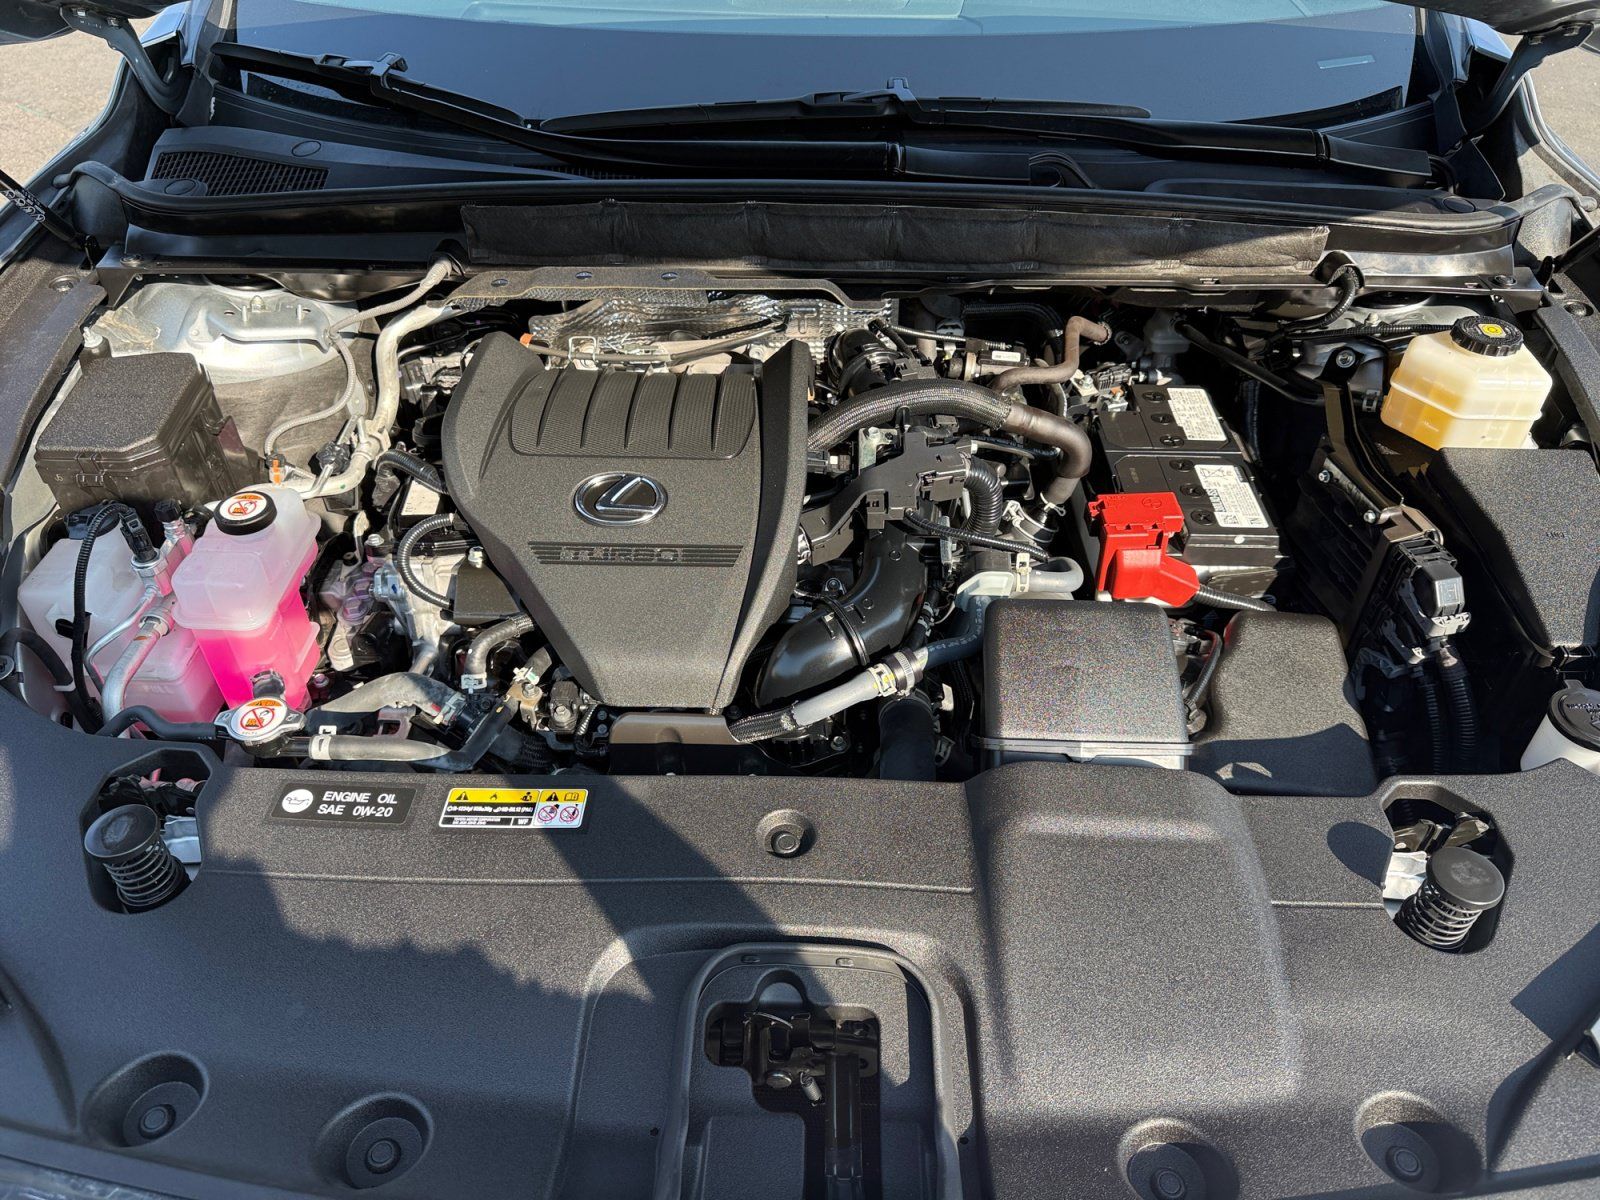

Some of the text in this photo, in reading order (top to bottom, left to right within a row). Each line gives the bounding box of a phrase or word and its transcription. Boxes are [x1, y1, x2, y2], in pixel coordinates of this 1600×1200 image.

[322, 790, 398, 804] ENGINE OIL
[317, 803, 394, 817] SAE 0W-20
